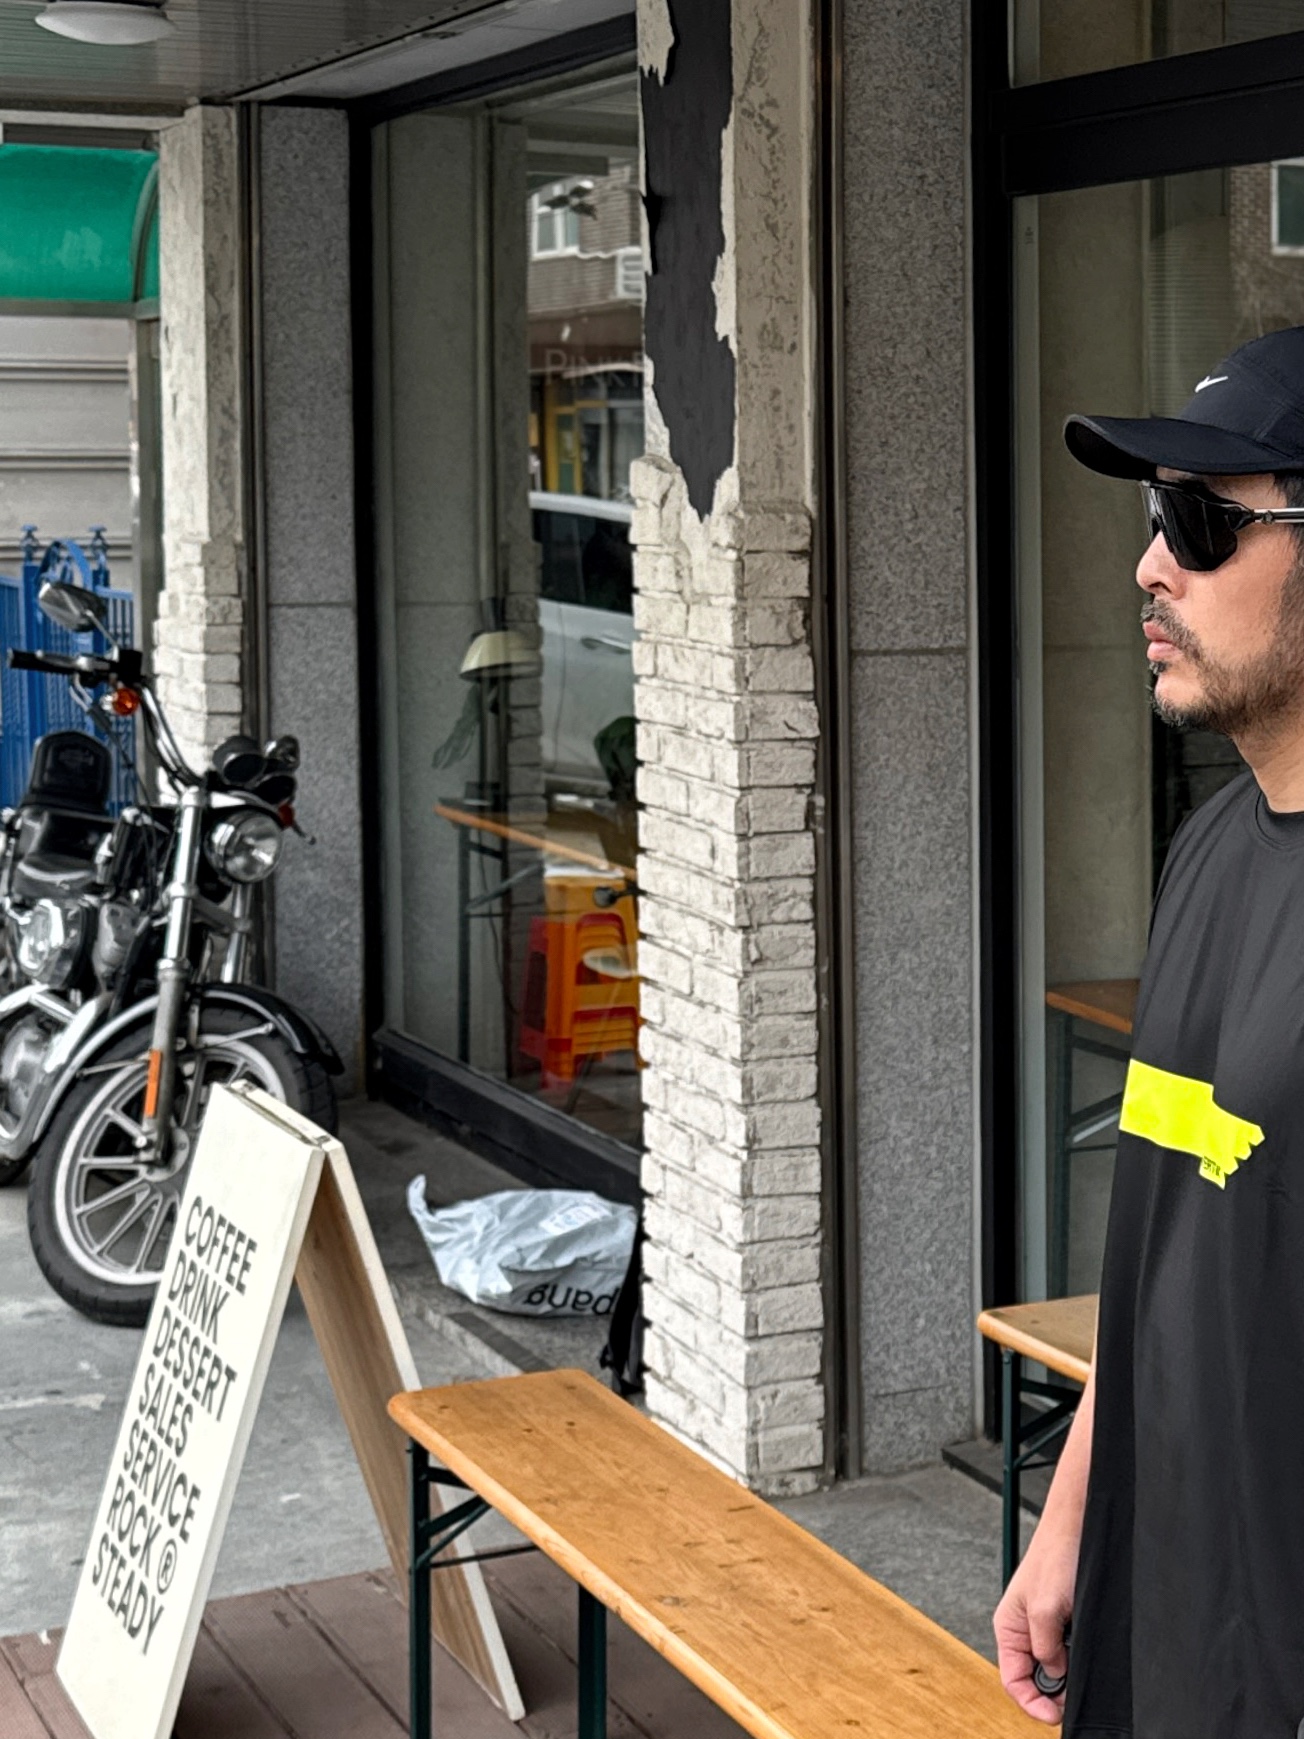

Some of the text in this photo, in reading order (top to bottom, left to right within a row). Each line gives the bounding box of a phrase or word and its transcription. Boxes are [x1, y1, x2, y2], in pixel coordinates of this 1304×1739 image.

[167, 1249, 230, 1345] DRINK
[185, 1196, 258, 1296] COFFEE
[138, 1362, 194, 1458] SALES
[152, 1305, 238, 1422] DESSERT
[106, 1474, 162, 1578] ROCK
[123, 1419, 201, 1544] SERVICE
[92, 1532, 165, 1656] STEADY
